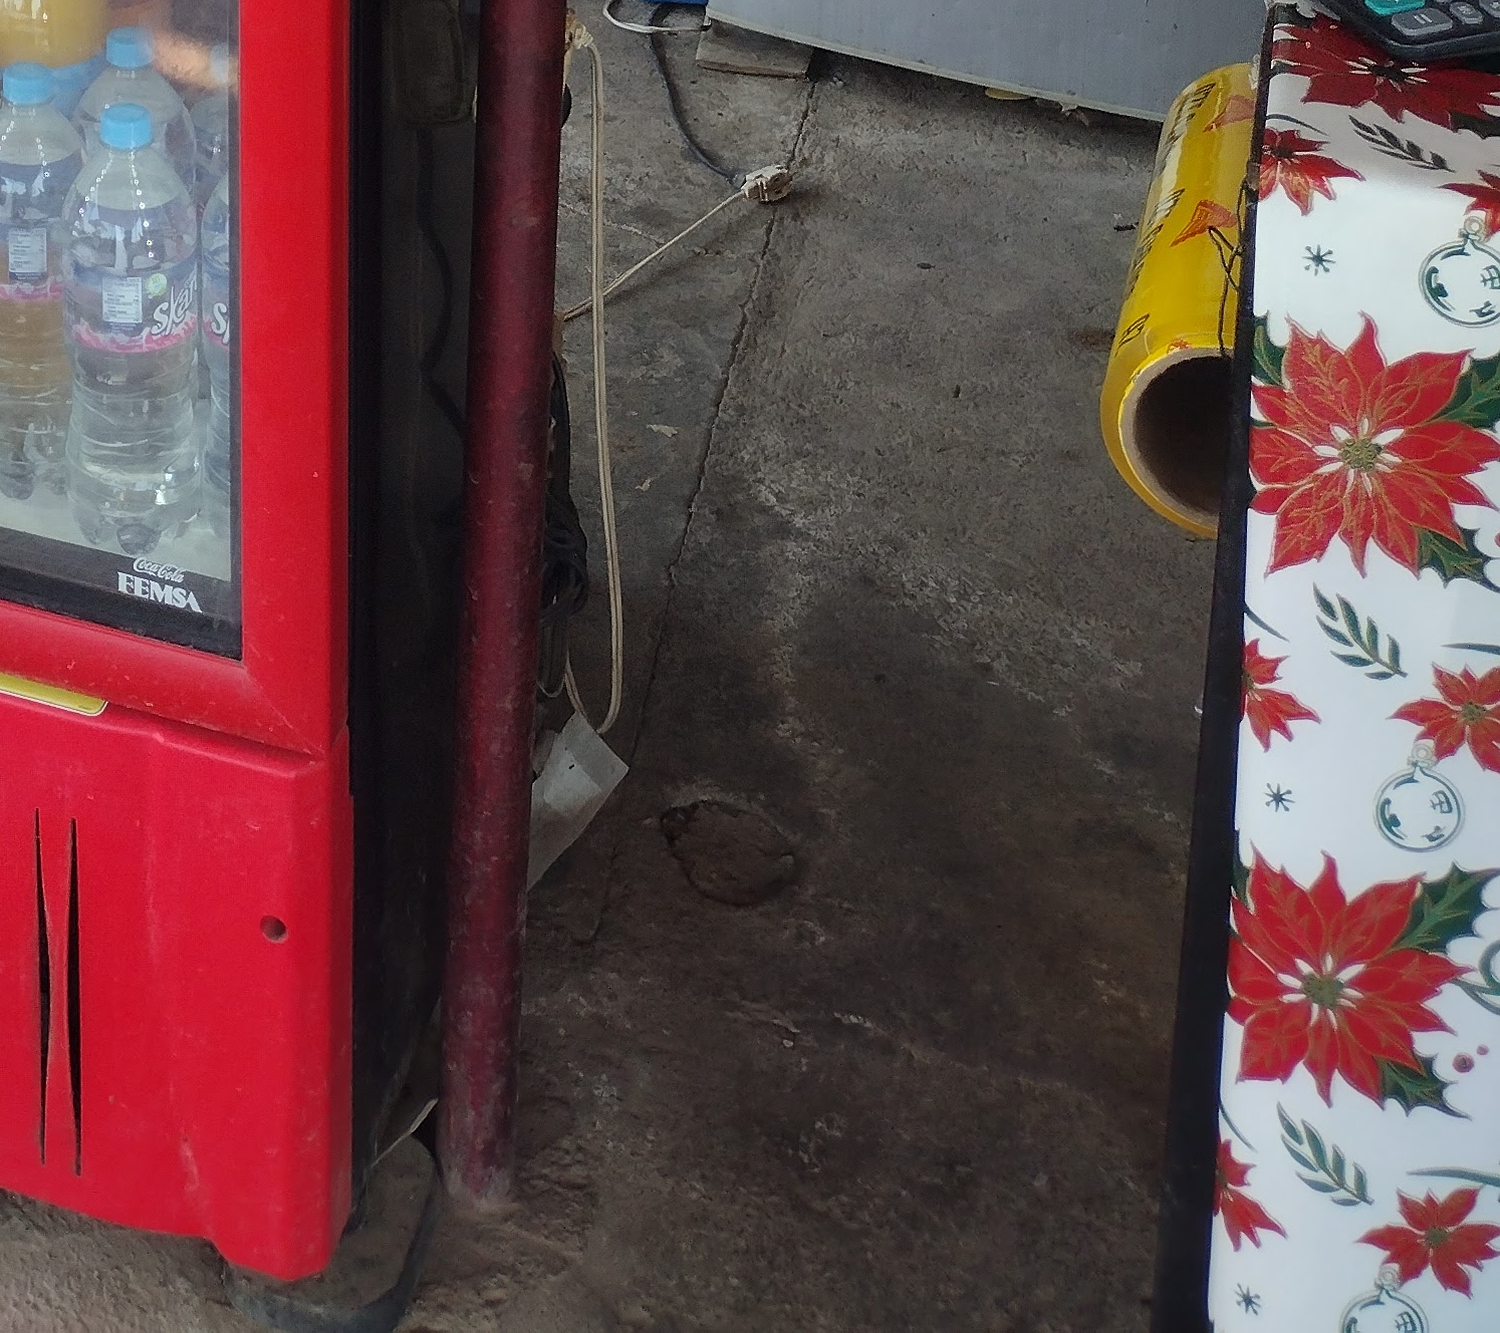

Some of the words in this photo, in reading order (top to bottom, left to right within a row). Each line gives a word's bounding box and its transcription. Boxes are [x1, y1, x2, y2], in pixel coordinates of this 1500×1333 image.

[152, 267, 198, 336] Skar
[133, 556, 185, 583] Coca-Cola
[117, 571, 203, 614] FEMSA
